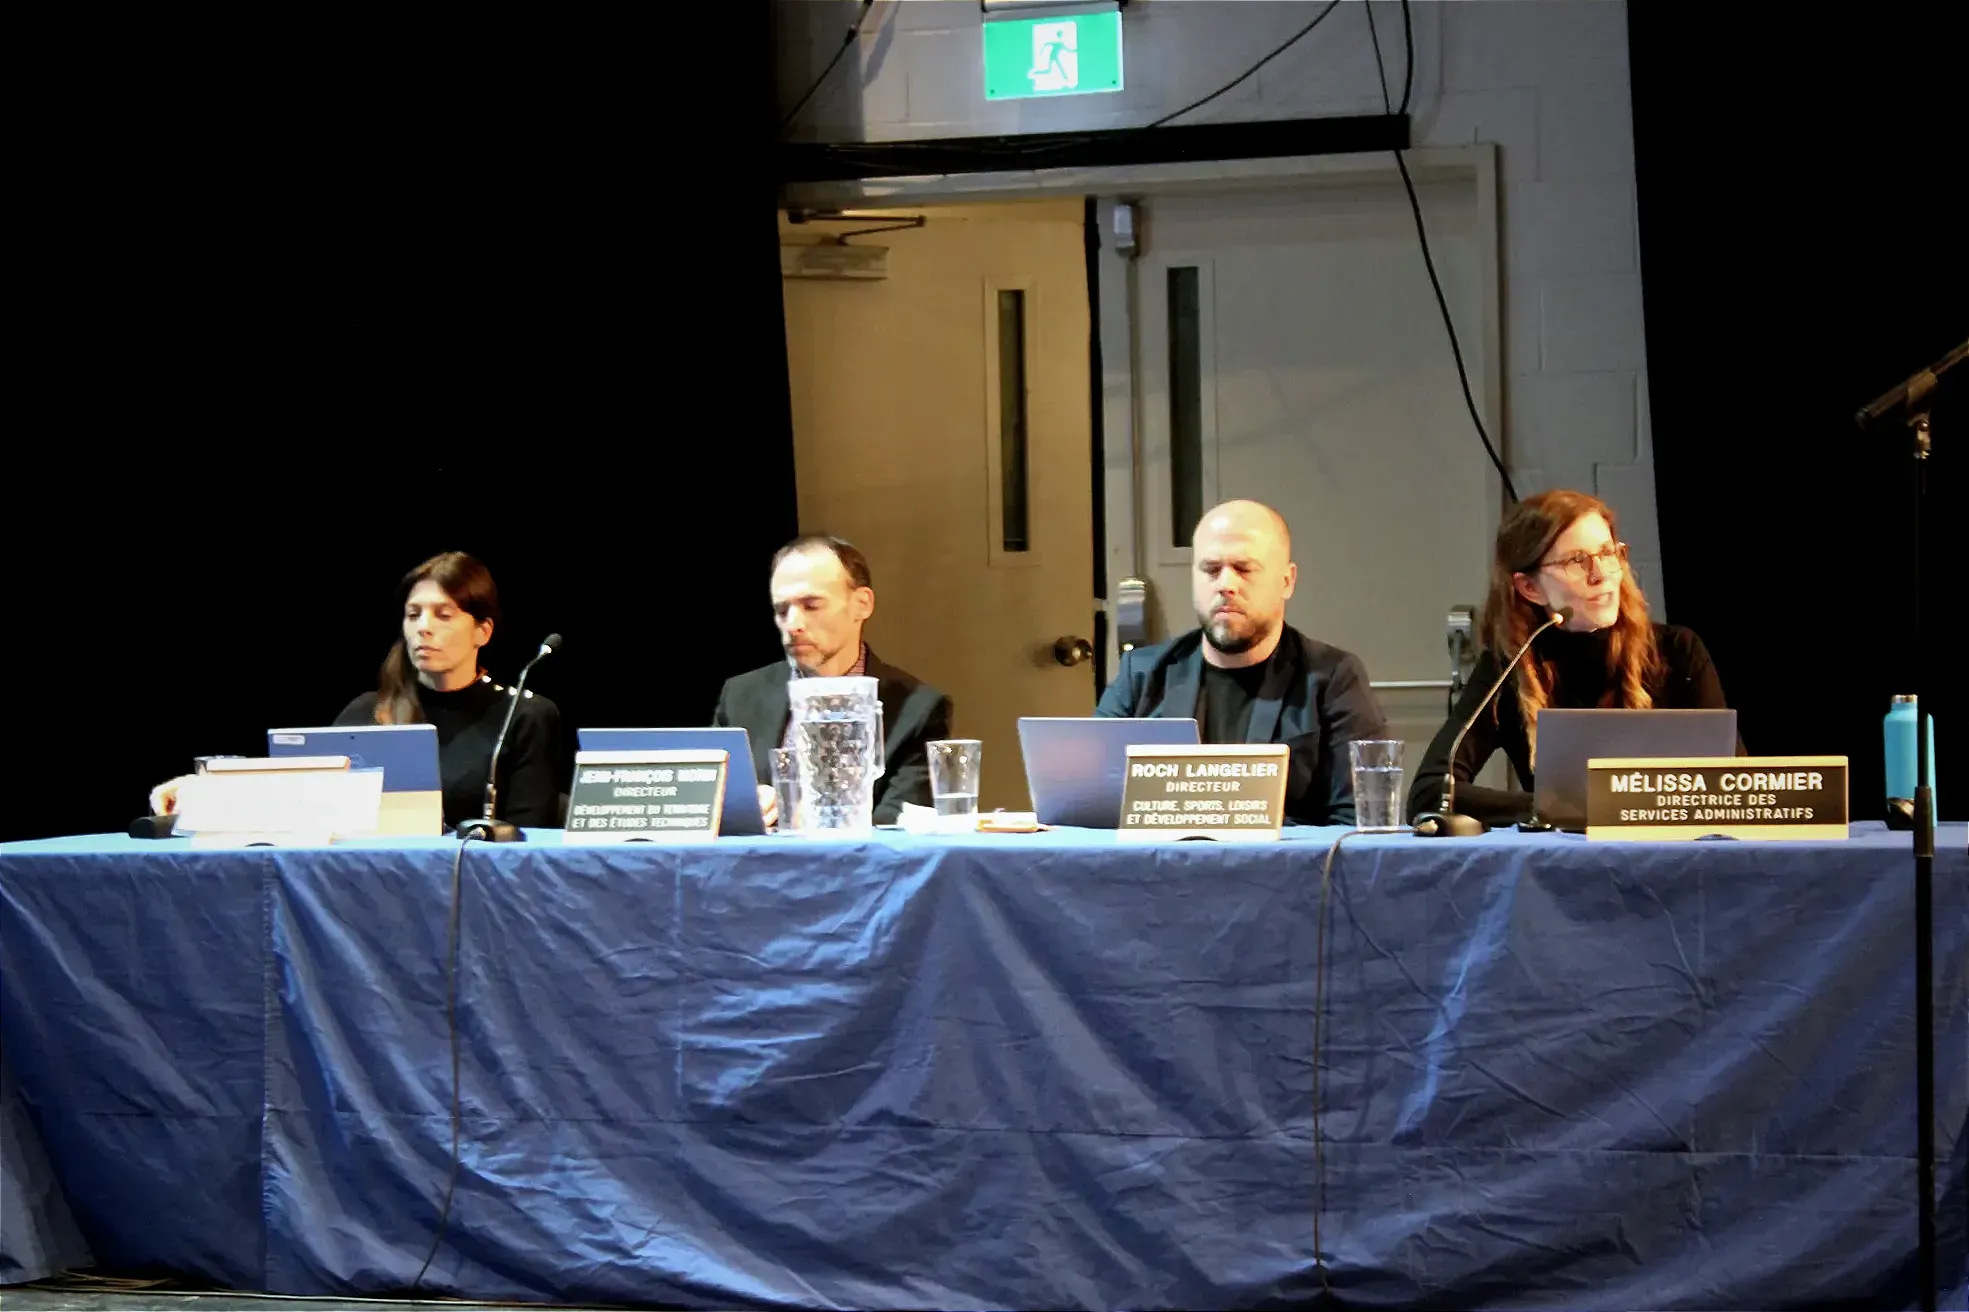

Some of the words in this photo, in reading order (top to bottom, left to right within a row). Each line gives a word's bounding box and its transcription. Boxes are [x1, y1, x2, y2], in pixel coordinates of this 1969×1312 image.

[1131, 763, 1179, 778] ROCH
[1185, 763, 1279, 778] LANGELIER
[1165, 781, 1241, 793] DIRECTEUR
[1610, 771, 1708, 793] MÉLISSA
[1719, 772, 1823, 791] CORMIER
[613, 786, 678, 798] DIRECTEUR
[1228, 800, 1268, 811] LOISIRS
[1656, 793, 1742, 807] DIRECTRICE
[1748, 793, 1777, 806] DES
[1126, 814, 1141, 825] ET
[1144, 813, 1231, 825] DÉVELOPPEMENT
[1234, 814, 1271, 825] SOCIAL
[1619, 808, 1689, 822] SERVICES
[1694, 807, 1814, 820] ADMINISTRATIFS
[571, 818, 587, 829] ET
[587, 818, 608, 828] DES
